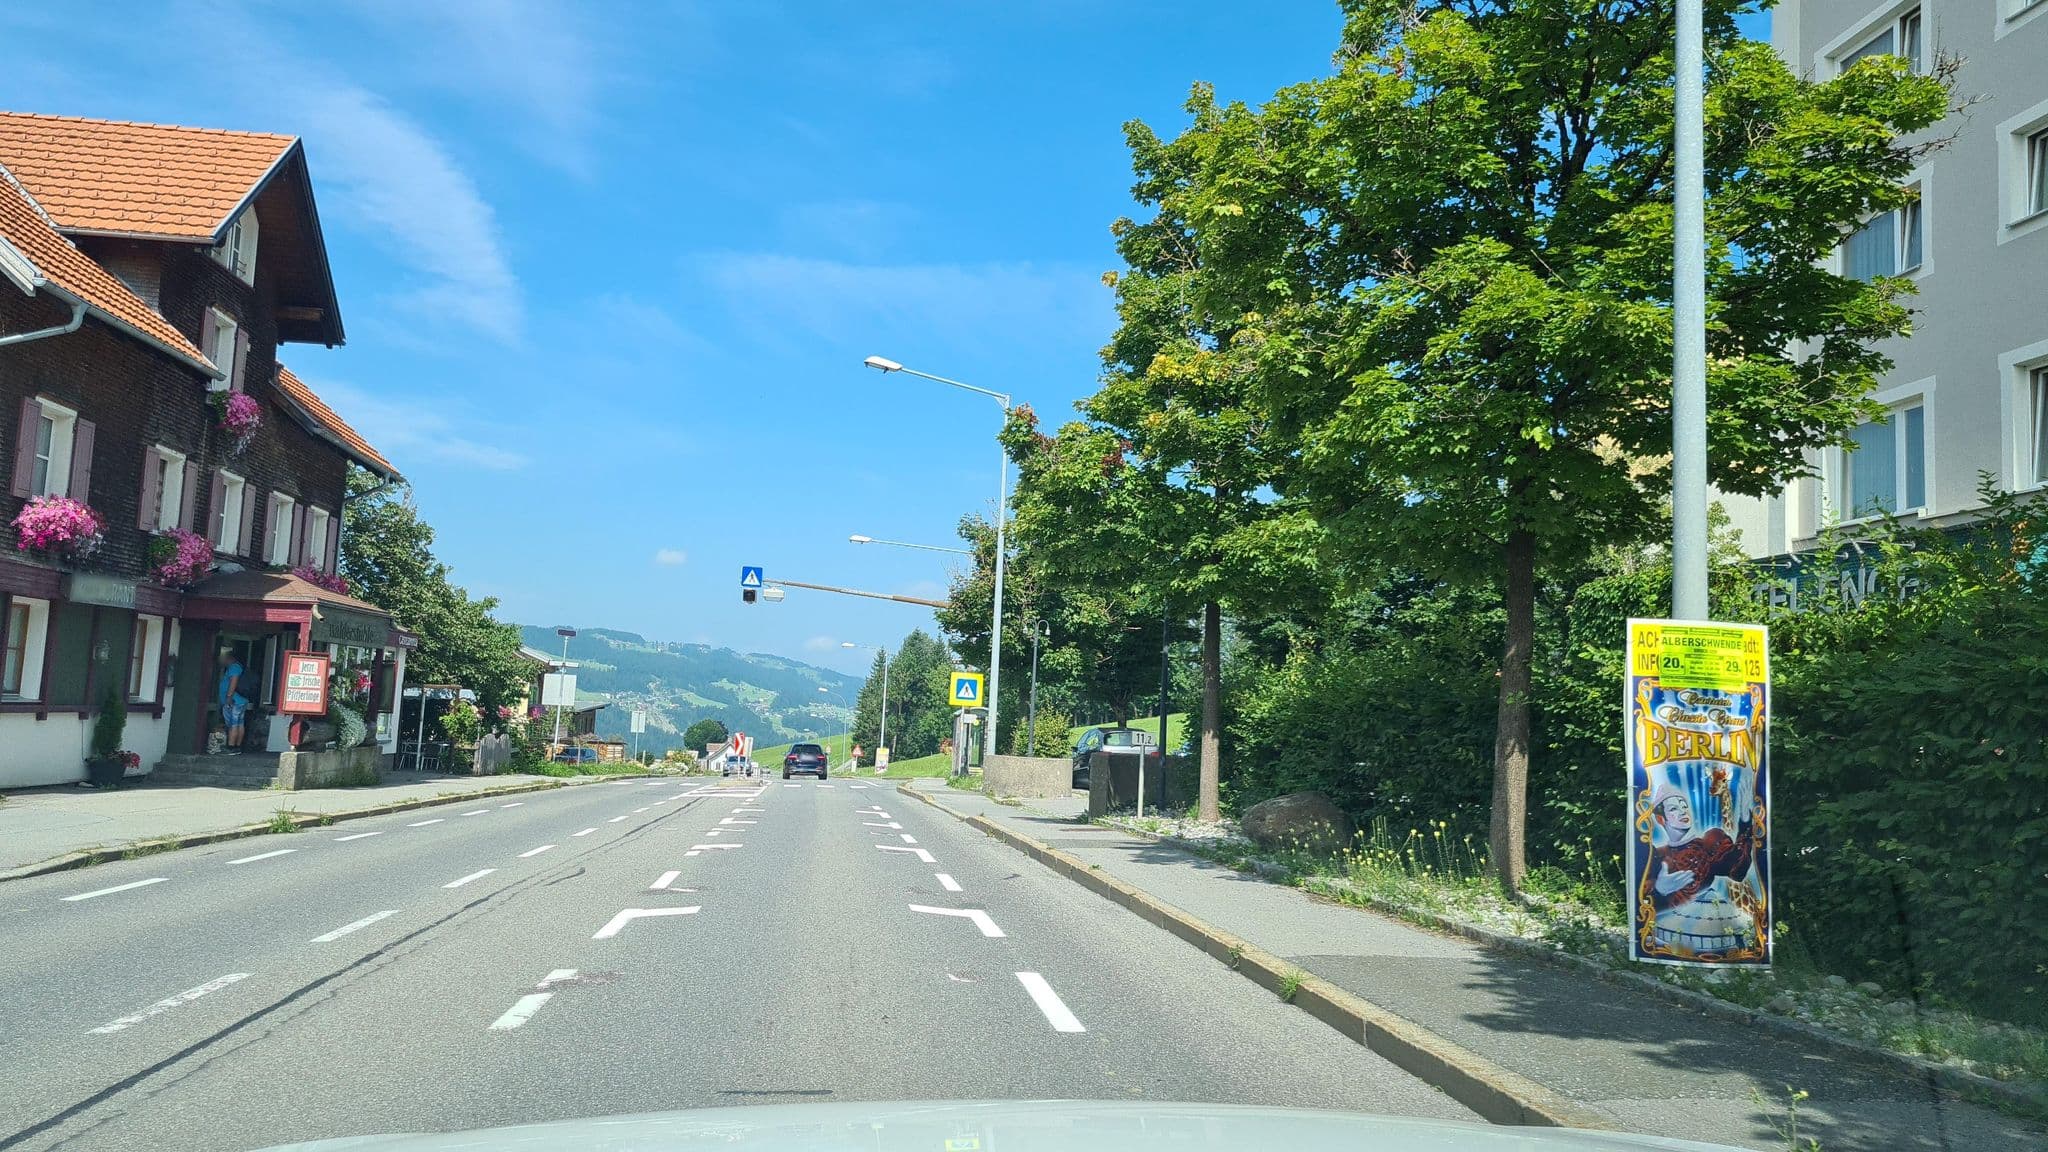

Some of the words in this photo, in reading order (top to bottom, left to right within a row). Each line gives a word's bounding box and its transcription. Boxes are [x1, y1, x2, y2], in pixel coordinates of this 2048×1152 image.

[1661, 636, 1742, 650] ALBERSCHWENDE
[1663, 657, 1685, 669] 20.
[1643, 718, 1759, 773] BERLIN
